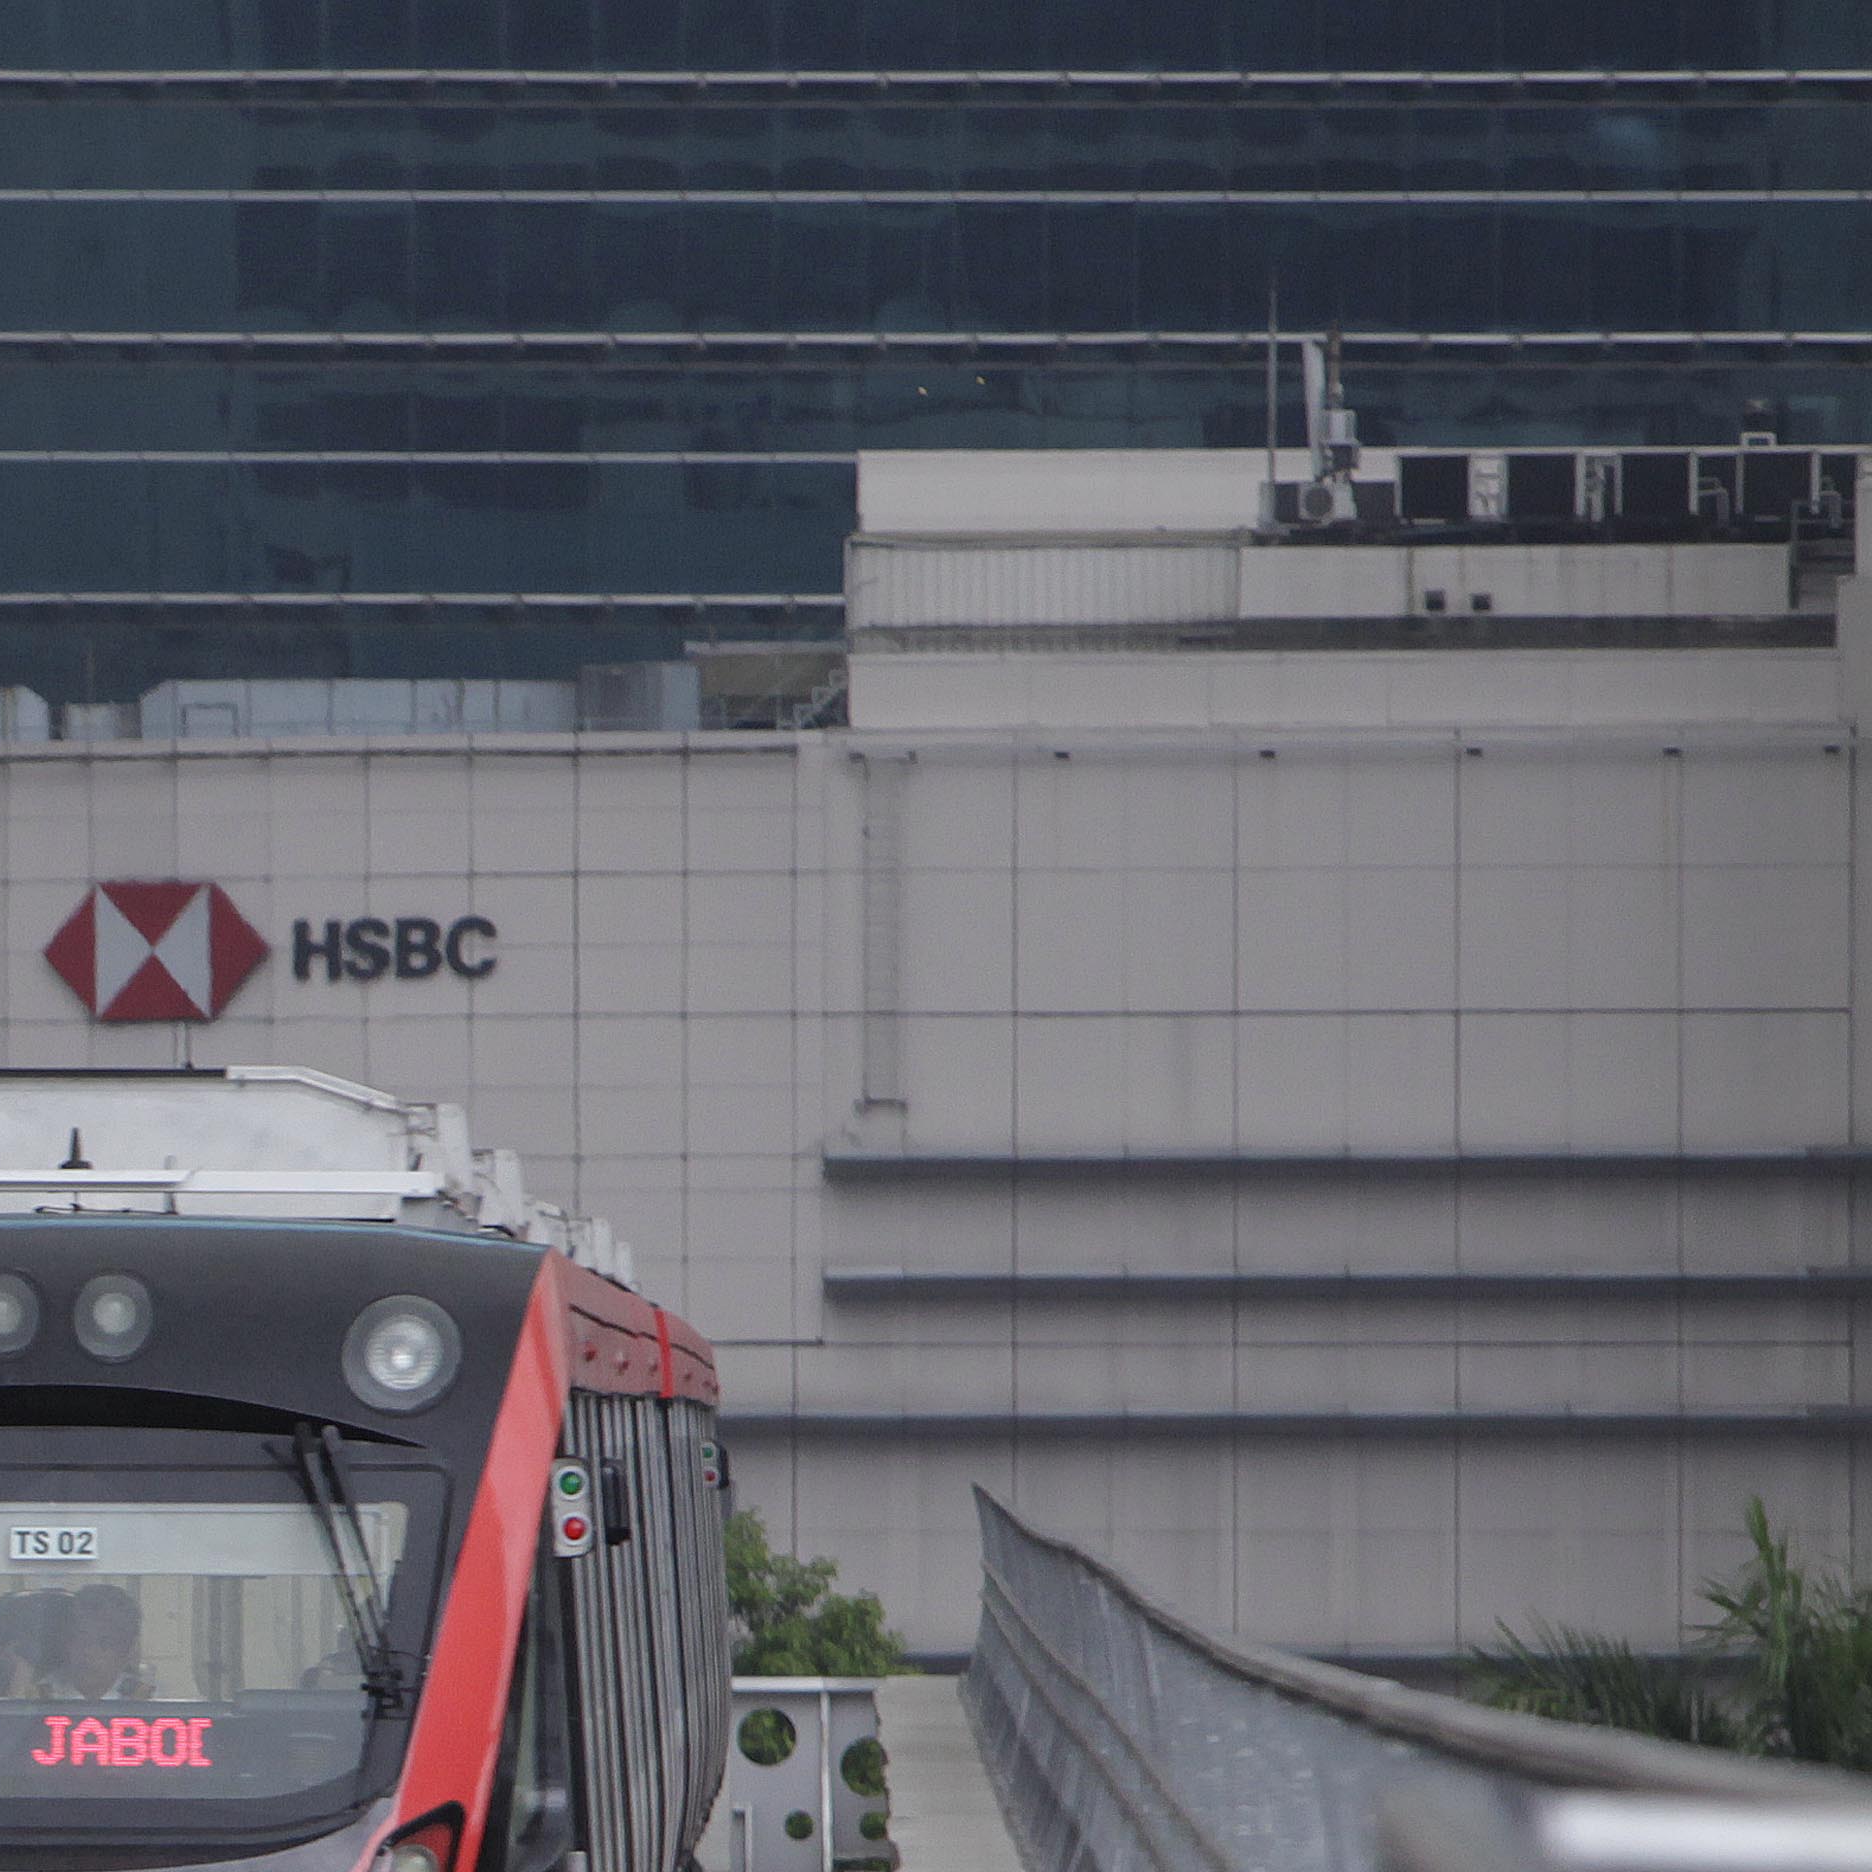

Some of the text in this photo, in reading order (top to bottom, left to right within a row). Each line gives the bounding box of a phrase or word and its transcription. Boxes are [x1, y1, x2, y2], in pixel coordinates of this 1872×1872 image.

[291, 916, 498, 982] HSBC
[15, 1530, 93, 1555] TS 02
